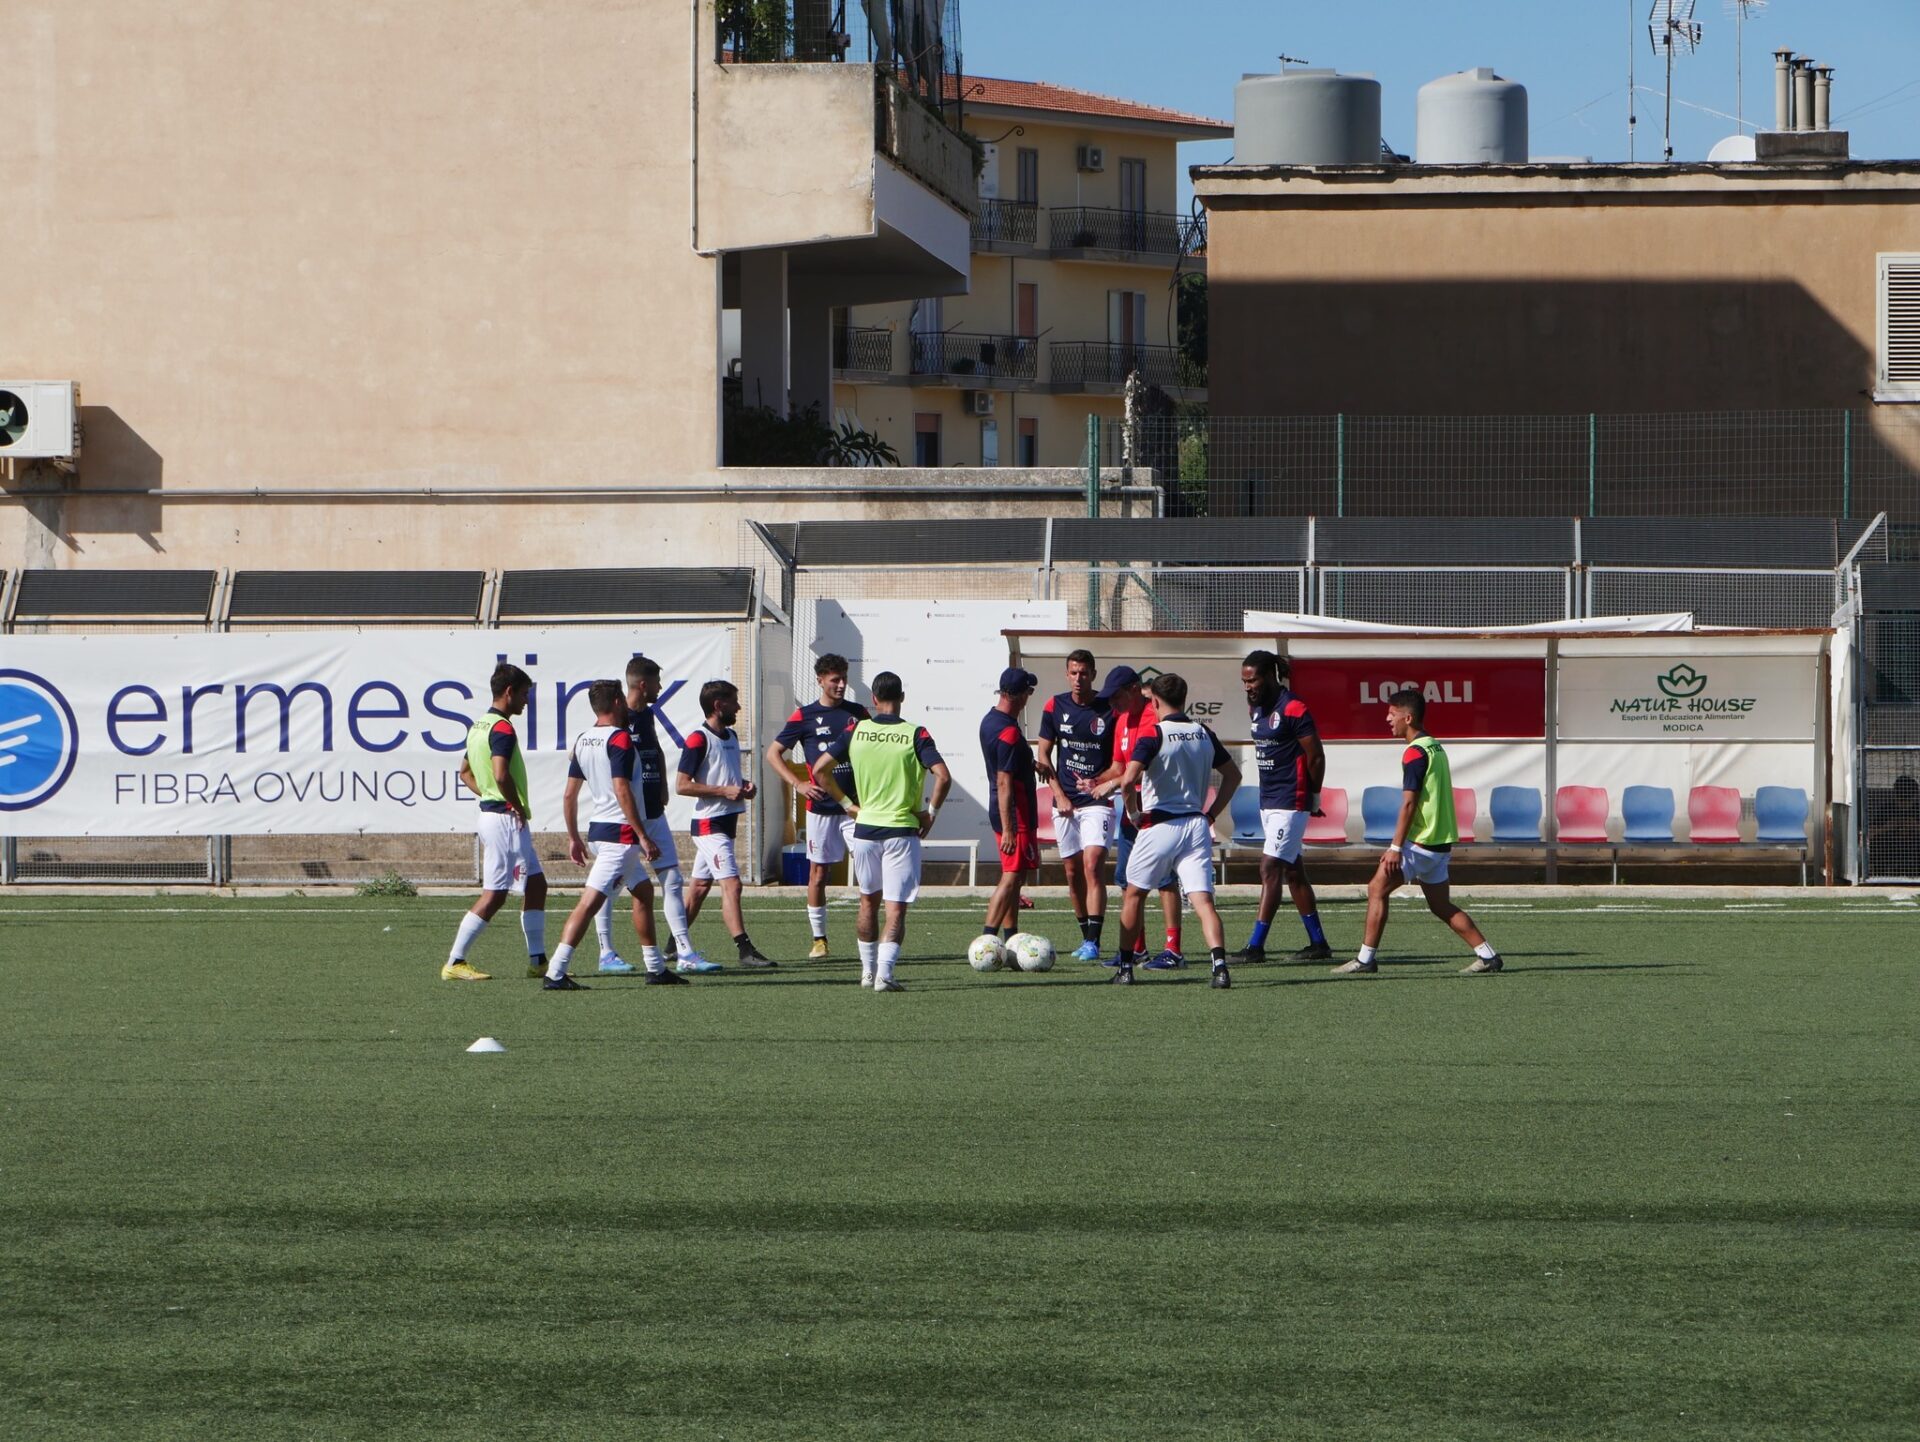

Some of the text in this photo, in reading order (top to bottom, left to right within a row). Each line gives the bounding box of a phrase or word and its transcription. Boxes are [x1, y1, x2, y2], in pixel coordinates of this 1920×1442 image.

[106, 653, 689, 756] ermesink
[1610, 698, 1757, 712] NATUR HOUSE
[1663, 724, 1704, 732] MODICA
[856, 731, 909, 745] macron
[115, 770, 476, 807] FIBRA OVUNQUE
[1103, 820, 1108, 831] 8
[1276, 828, 1284, 840] 9
